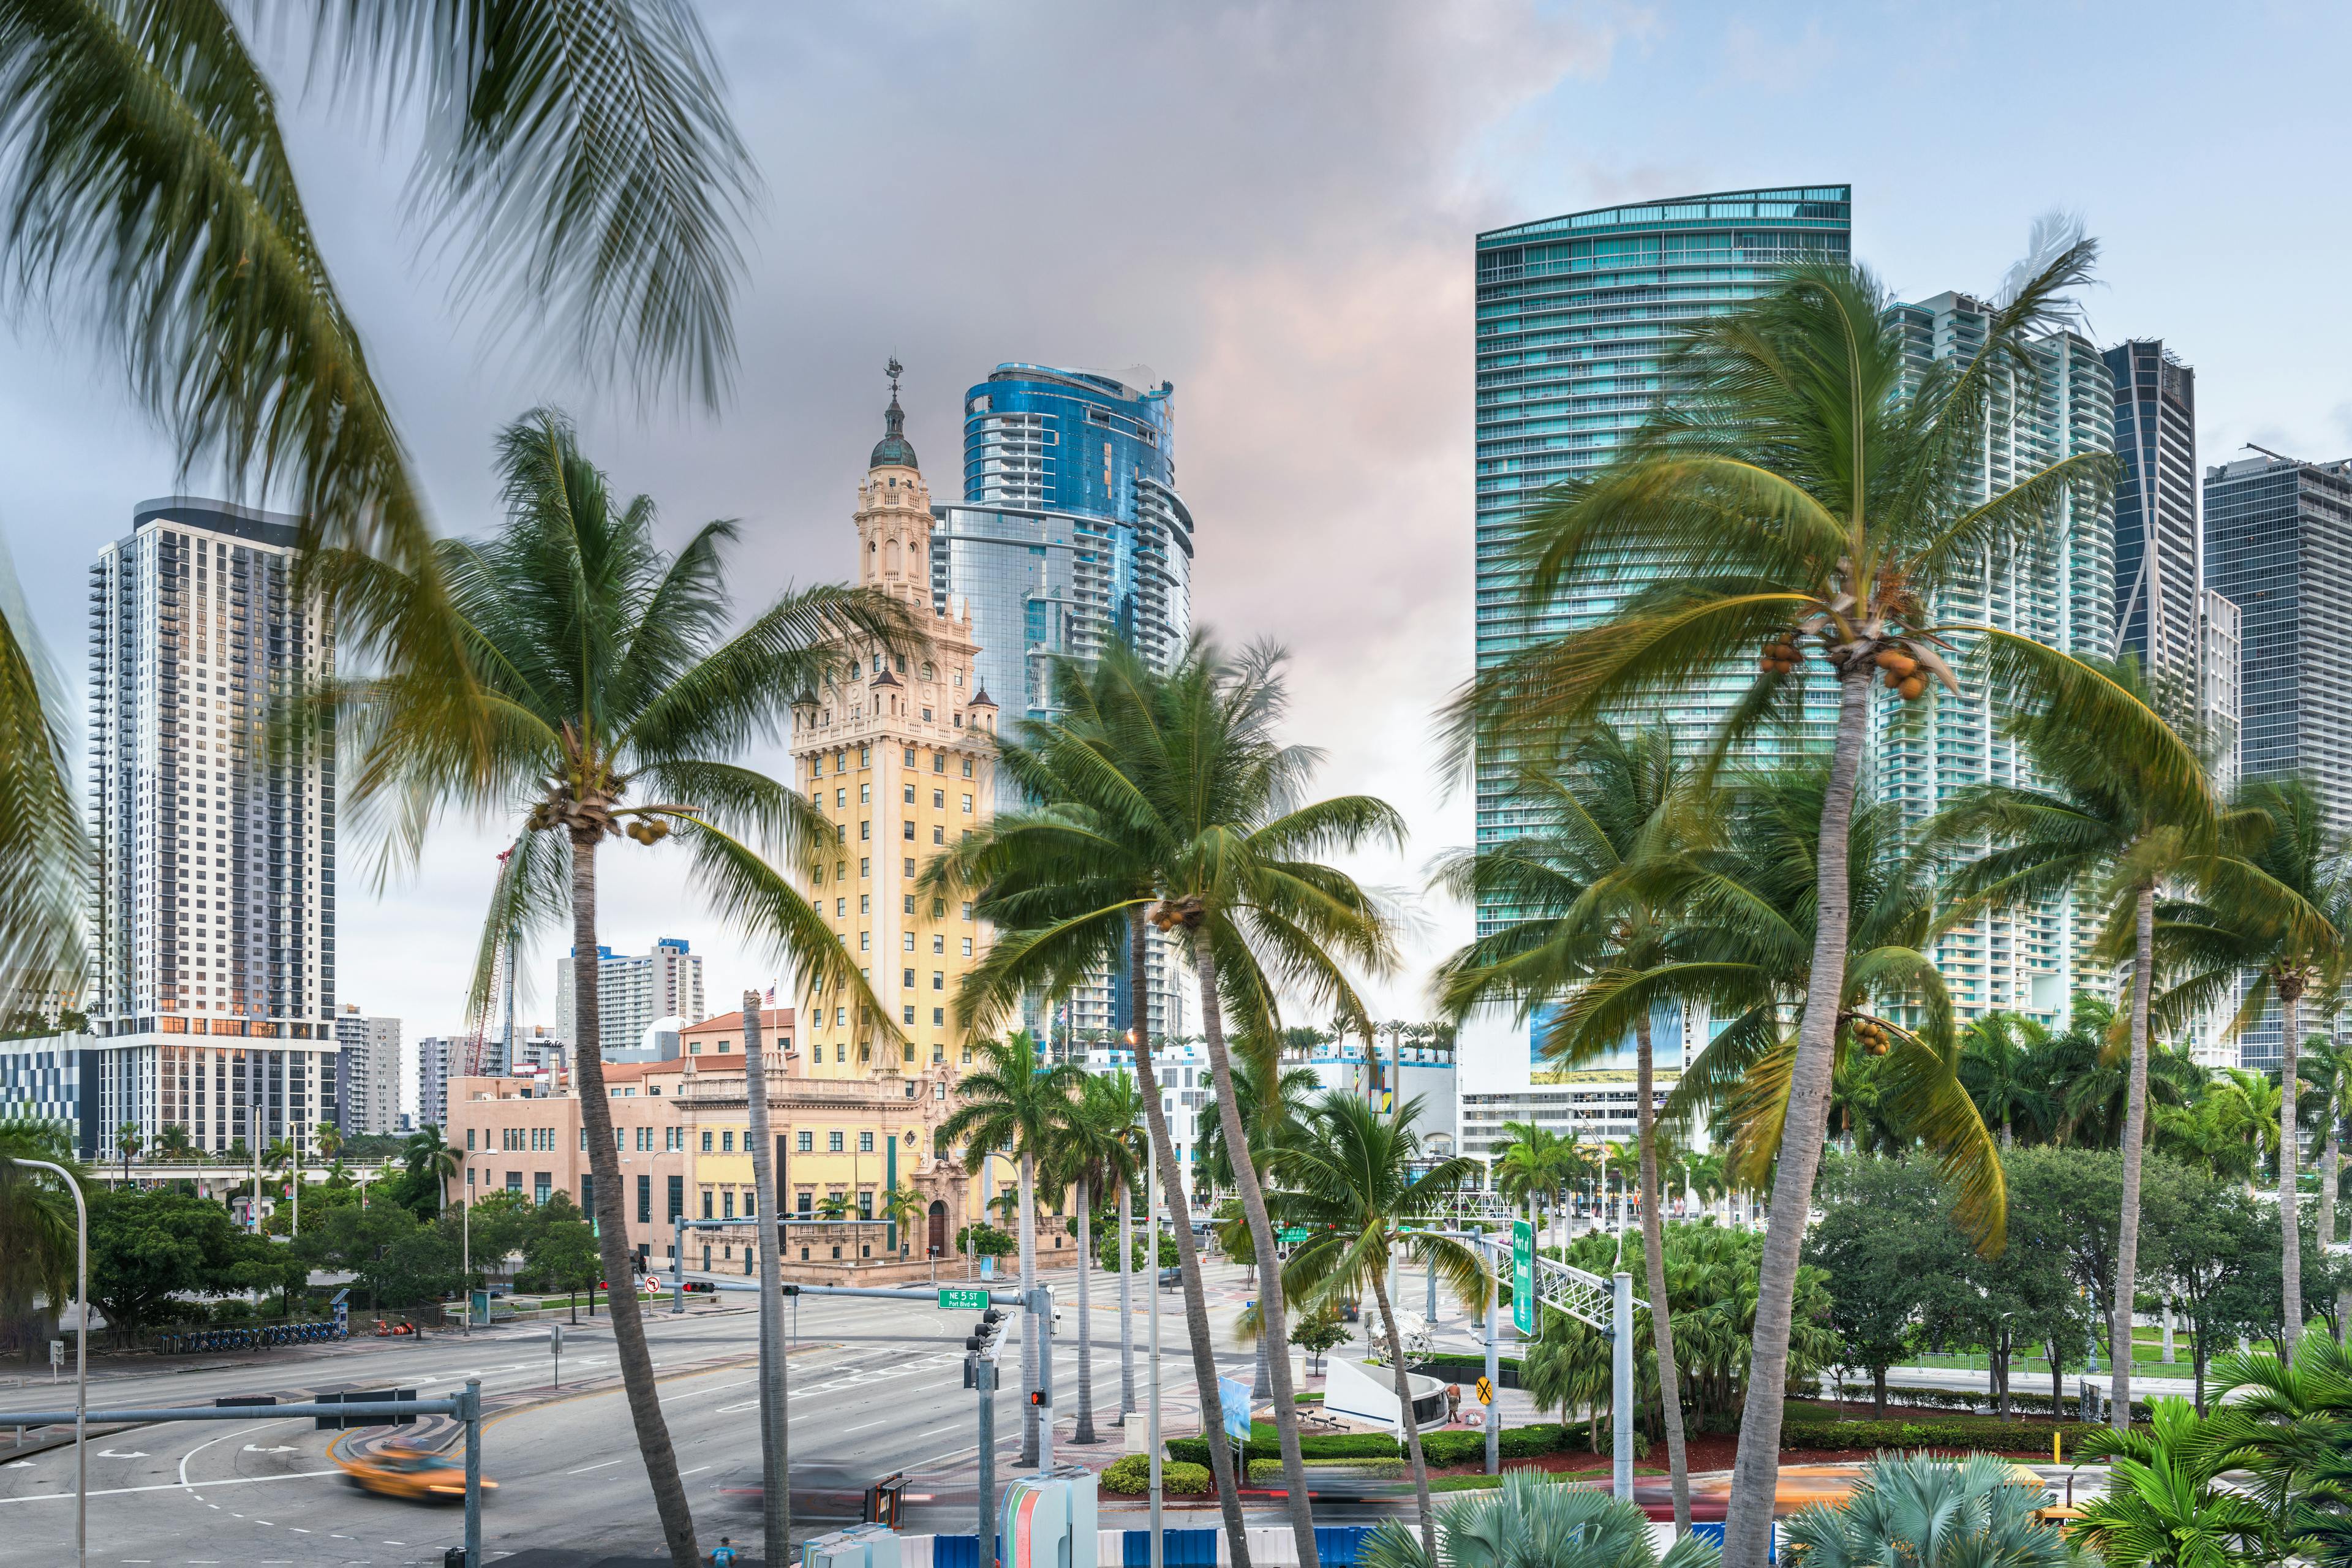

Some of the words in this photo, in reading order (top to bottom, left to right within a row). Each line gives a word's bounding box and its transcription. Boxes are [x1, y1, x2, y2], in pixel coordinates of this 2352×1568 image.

[1515, 1233, 1524, 1251] Port
[1525, 1237, 1529, 1253] of
[1517, 1259, 1528, 1279] Miami
[961, 1291, 967, 1300] 5
